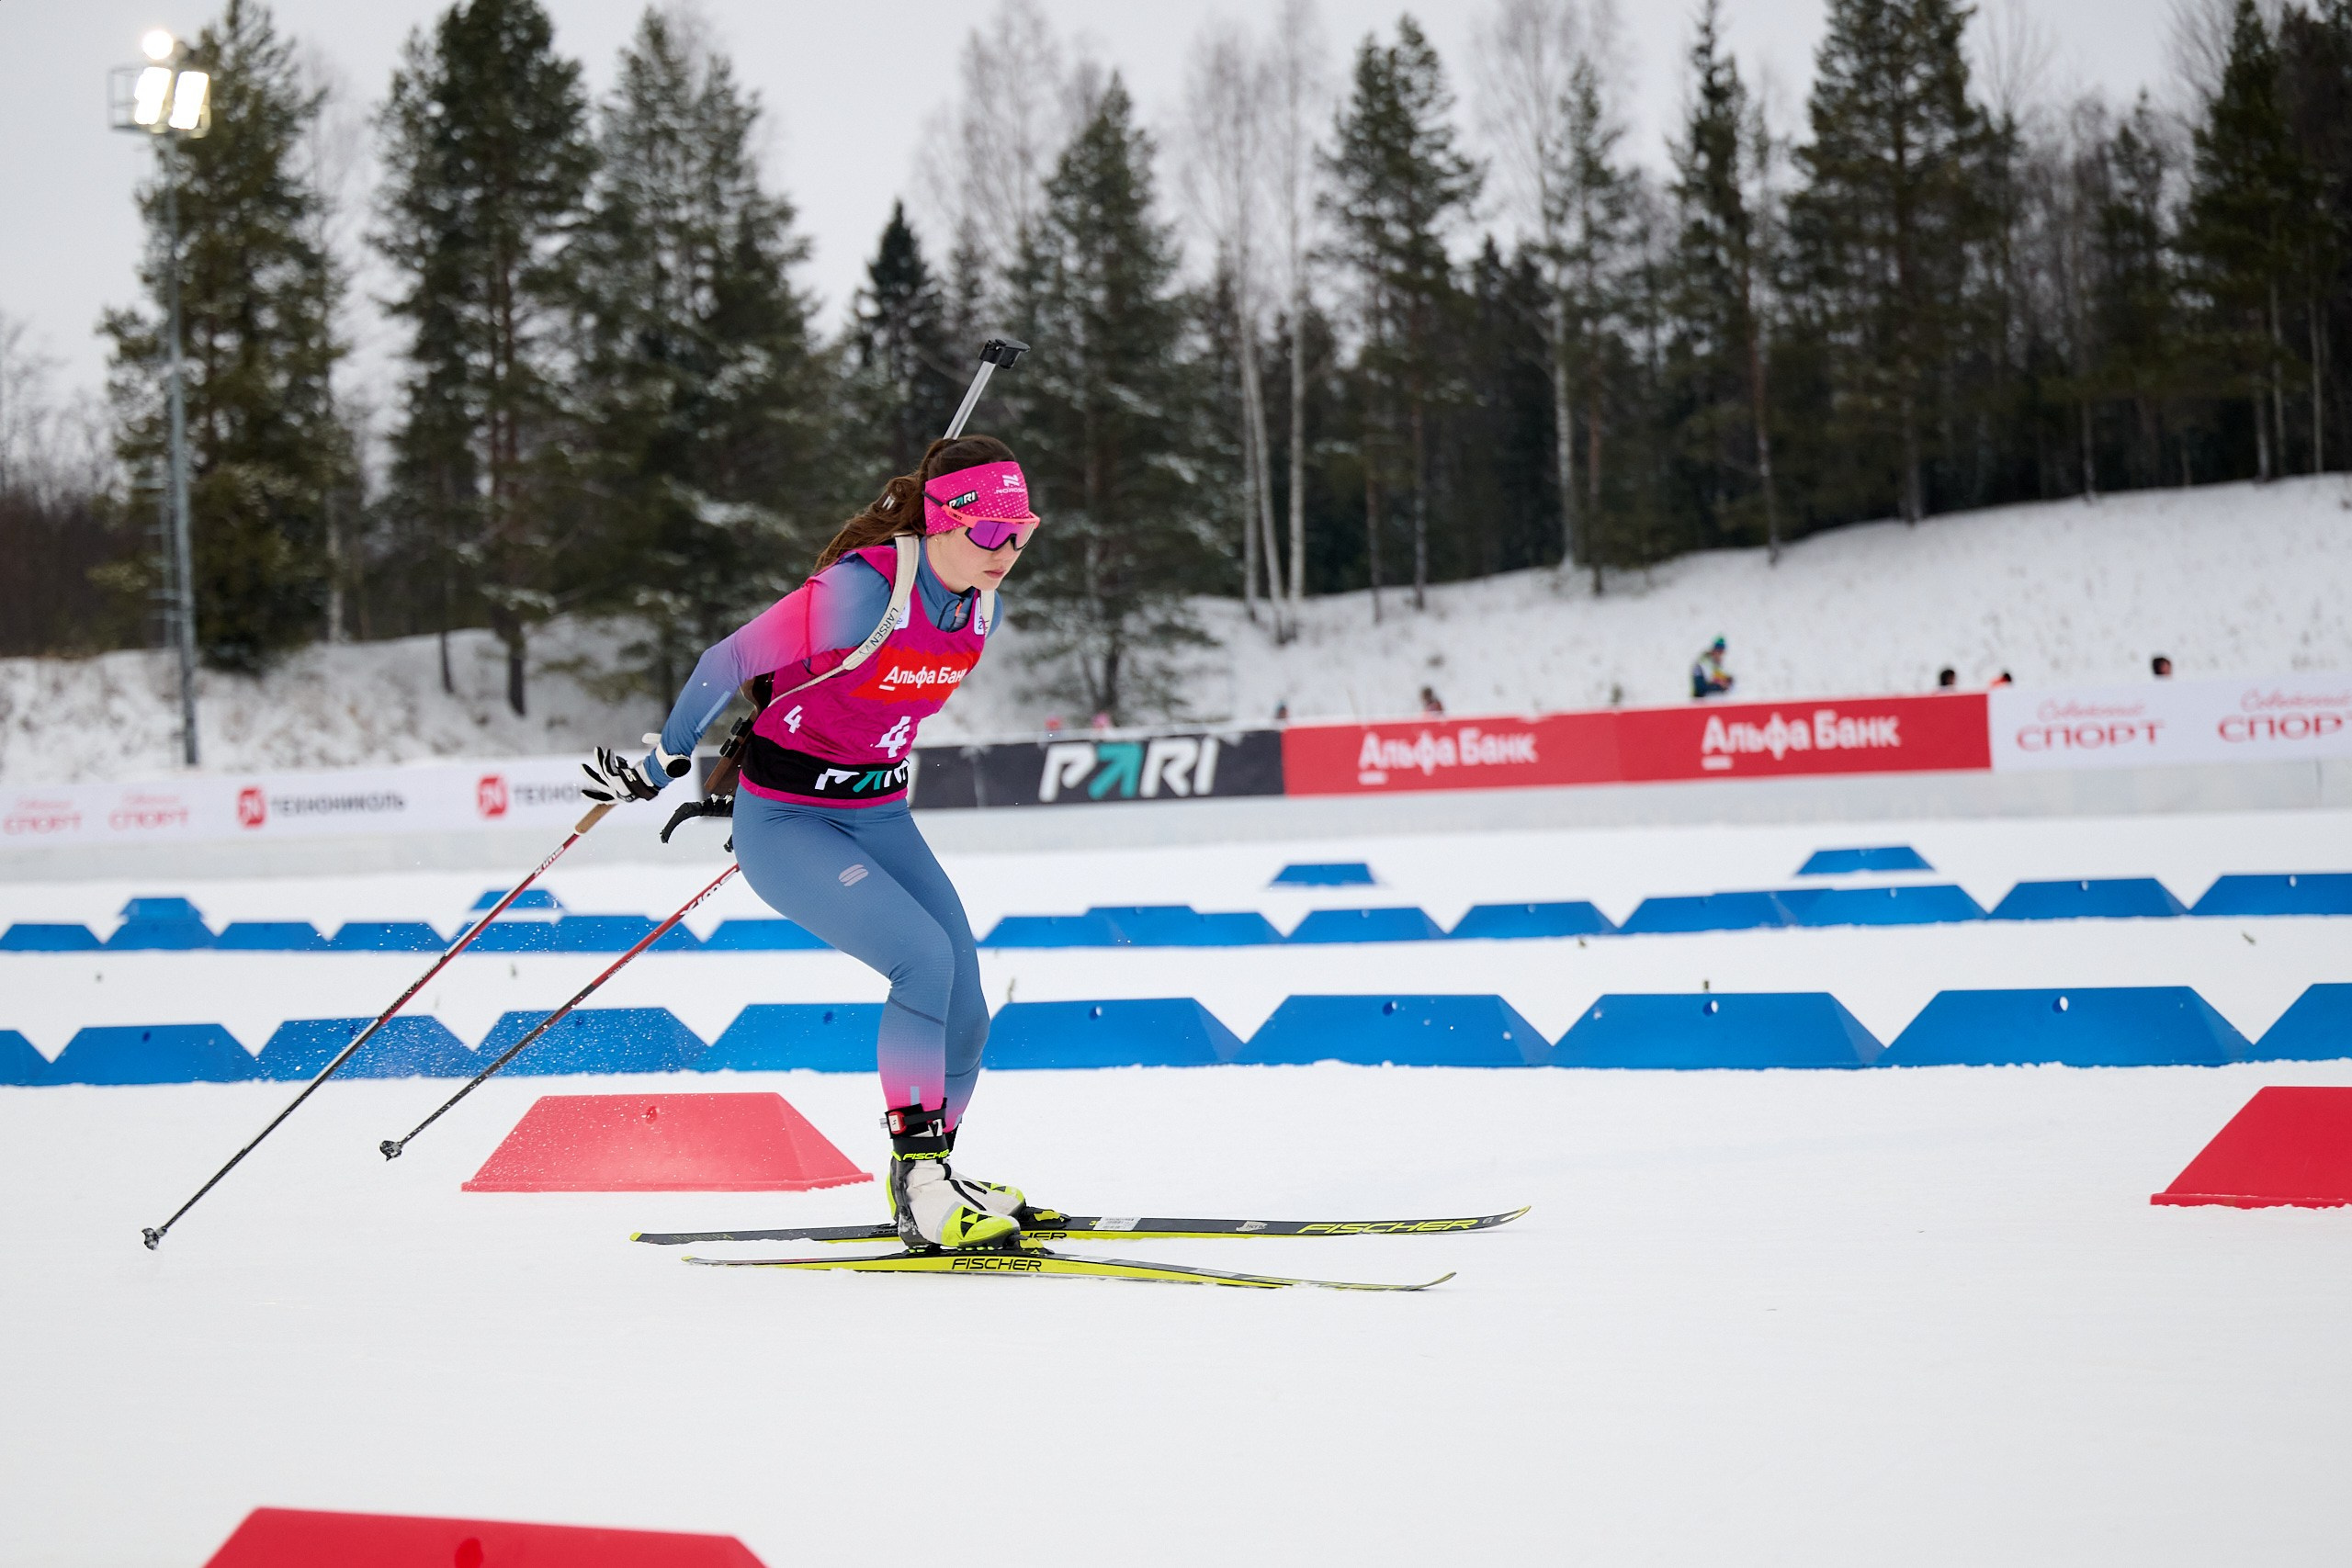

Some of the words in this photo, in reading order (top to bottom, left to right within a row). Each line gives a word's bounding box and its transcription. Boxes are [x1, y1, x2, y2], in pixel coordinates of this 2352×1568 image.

[949, 491, 976, 508] PARI
[868, 607, 899, 647] LARSEN
[882, 666, 935, 688] Альфа
[783, 705, 803, 734] 4
[1702, 712, 1812, 761] Альфа
[1814, 709, 1901, 750] Банк
[874, 716, 911, 759] 4
[2016, 720, 2165, 751] СПОРТ
[1359, 730, 1457, 776] Альфа
[1458, 727, 1539, 766] Банк
[1039, 737, 1219, 803] PARI
[1296, 1218, 1479, 1234] FISCHER
[952, 1258, 1042, 1272] FISCHER
